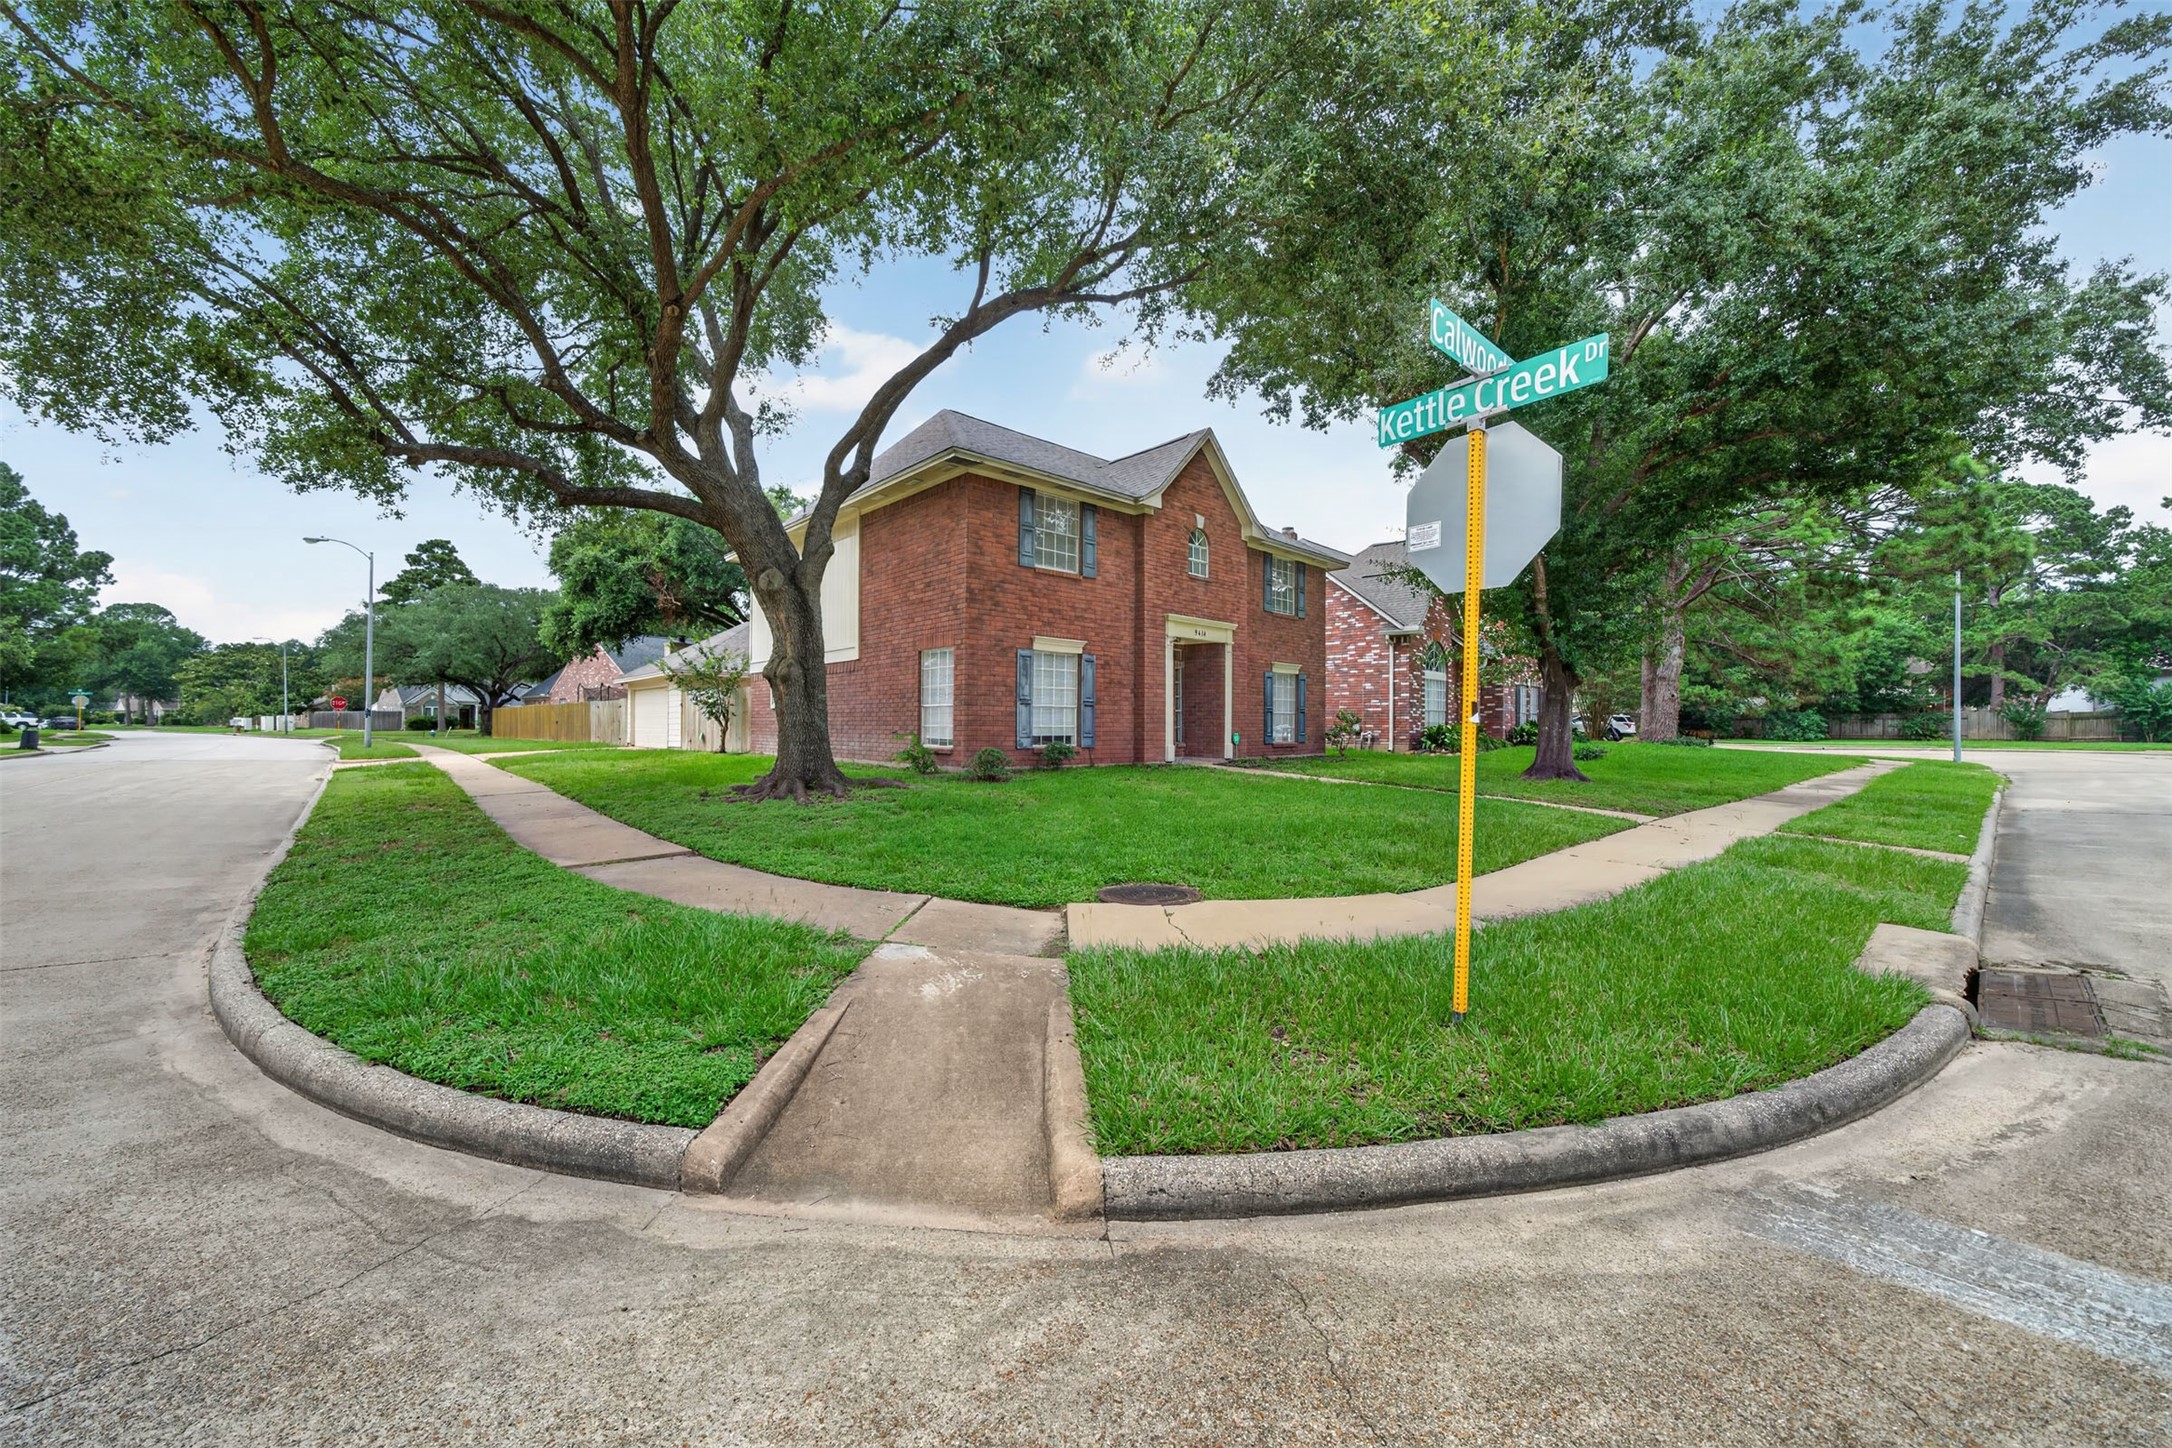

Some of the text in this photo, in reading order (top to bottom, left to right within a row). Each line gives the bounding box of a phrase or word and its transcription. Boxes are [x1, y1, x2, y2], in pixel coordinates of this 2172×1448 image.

[1380, 340, 1607, 443] Kettle Creek Dr
